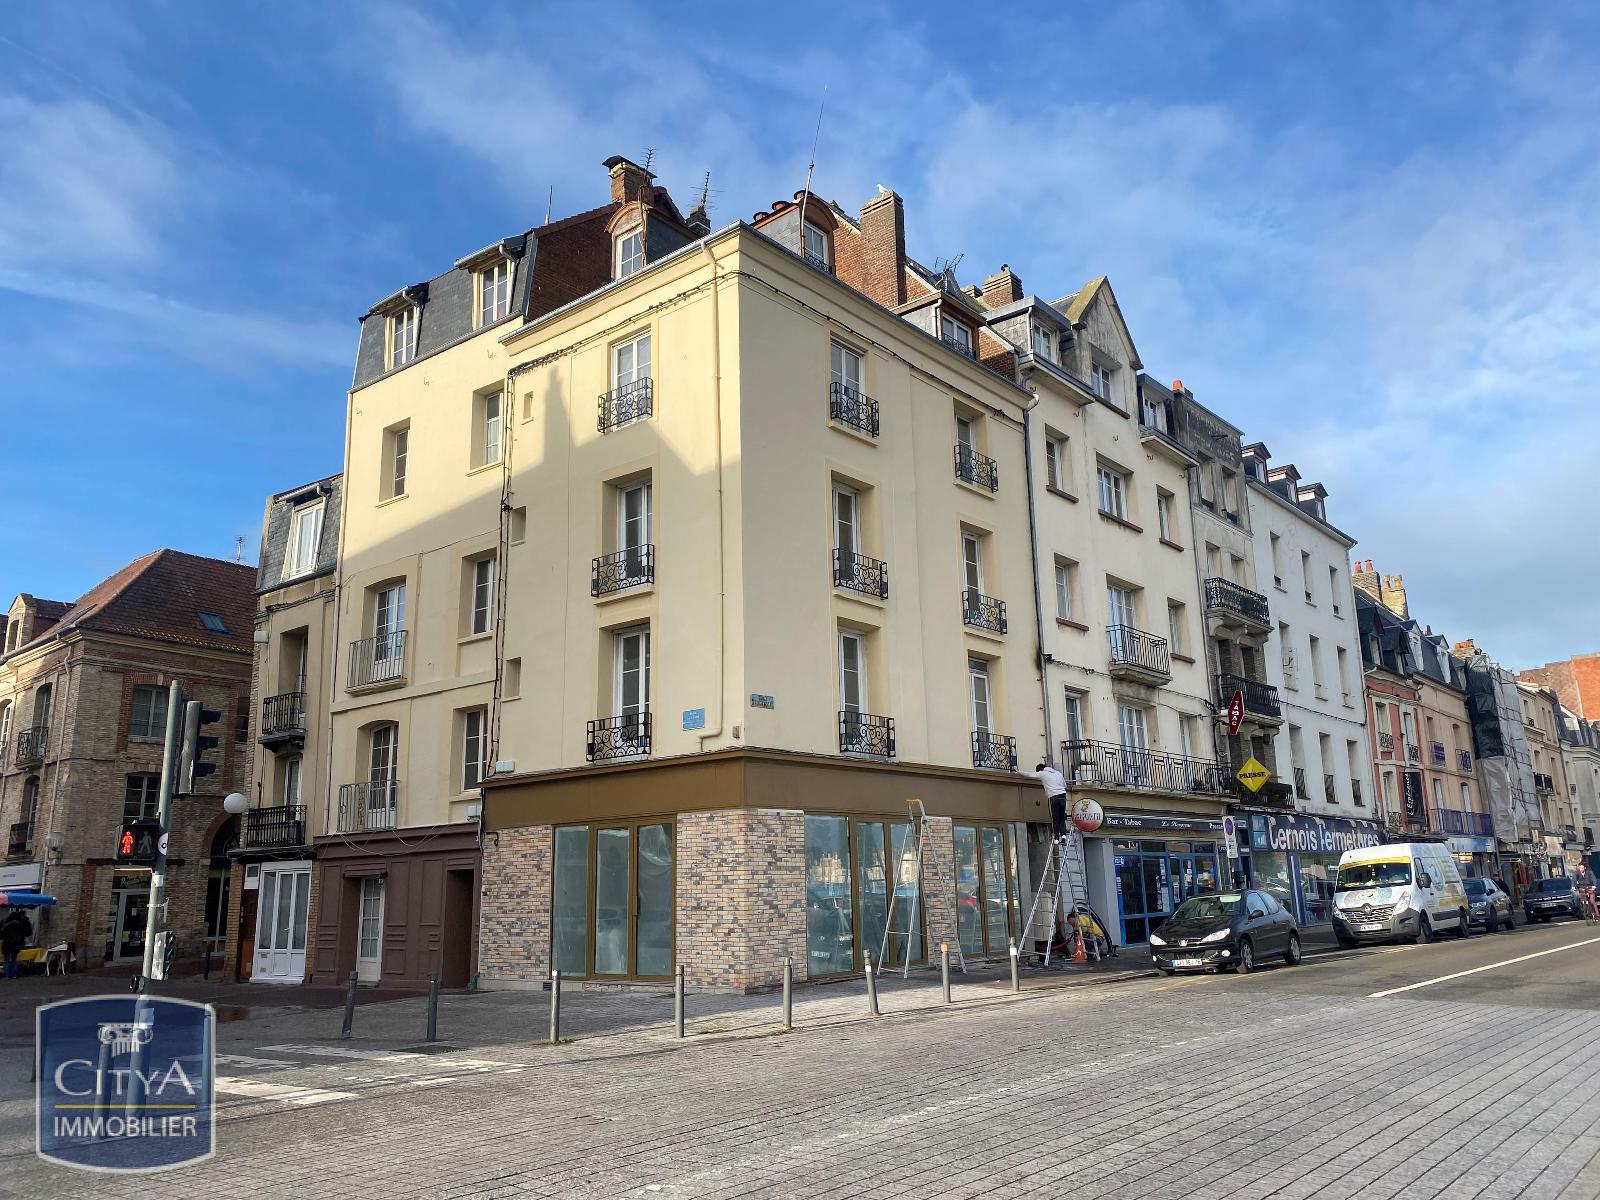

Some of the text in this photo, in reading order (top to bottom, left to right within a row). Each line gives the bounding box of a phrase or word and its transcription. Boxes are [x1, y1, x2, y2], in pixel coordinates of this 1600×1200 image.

[1232, 701, 1240, 726] TABAC
[1239, 771, 1267, 779] PRESSE
[1107, 817, 1118, 825] Bar
[1123, 818, 1142, 826] Tabac
